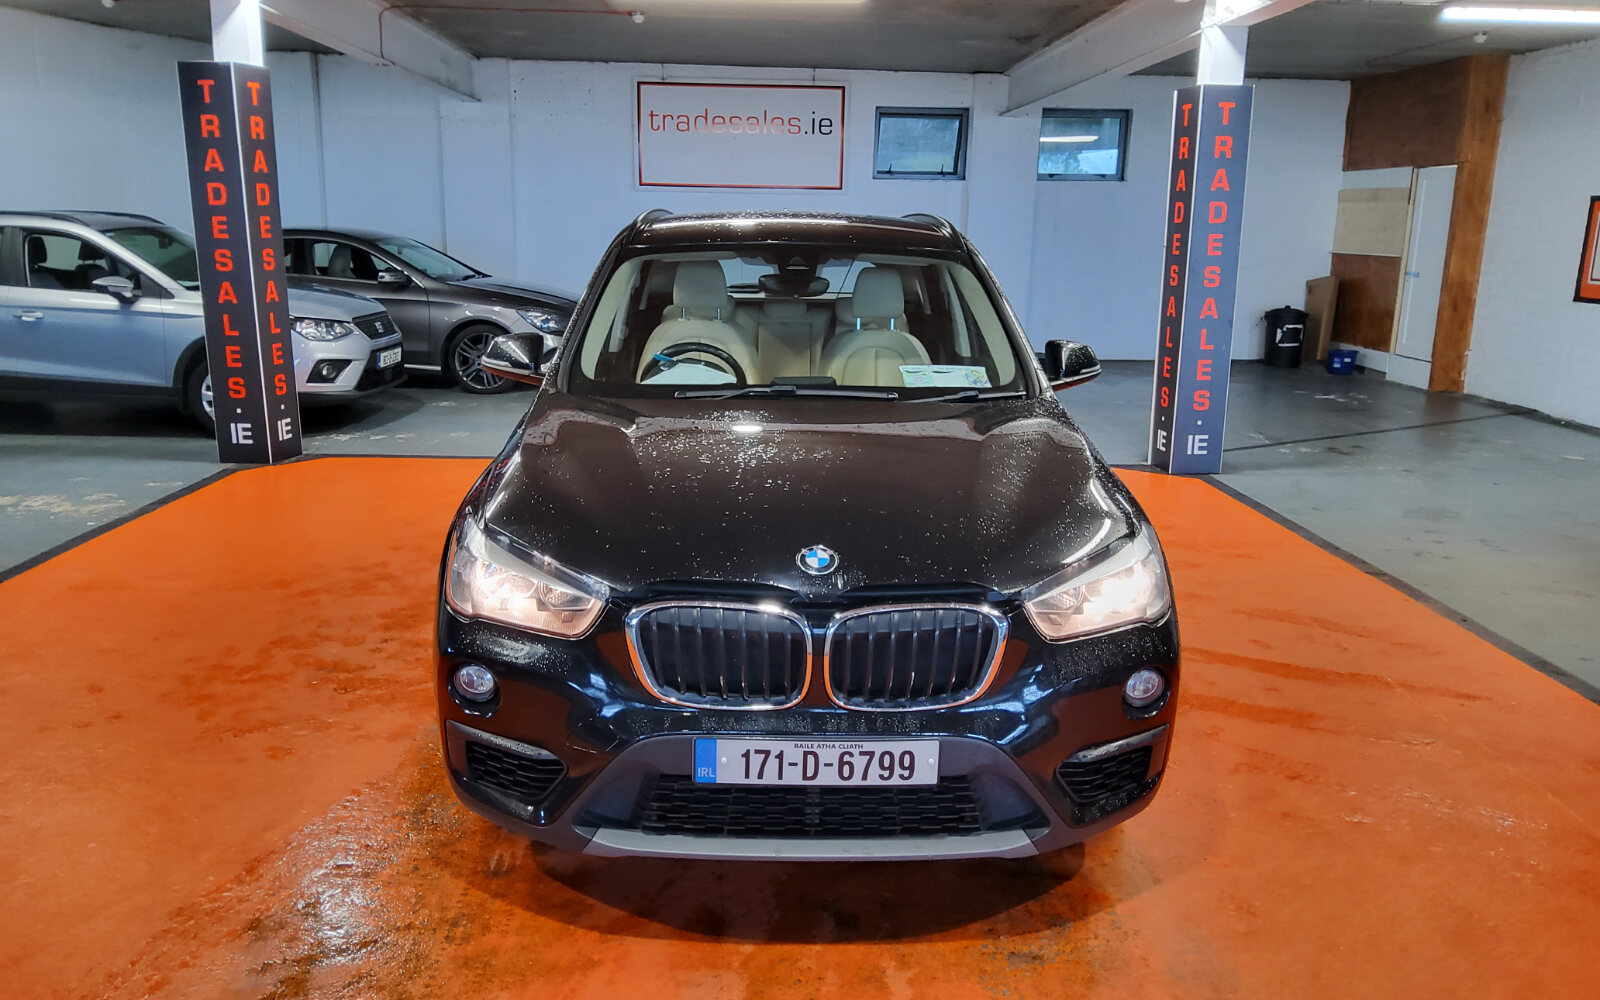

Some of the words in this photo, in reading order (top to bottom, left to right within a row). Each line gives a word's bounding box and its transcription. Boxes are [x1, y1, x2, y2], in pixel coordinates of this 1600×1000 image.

[197, 79, 253, 445] TRADESALES.IE
[246, 81, 293, 442] TRADESALES.IE
[648, 108, 833, 135] tradesales.ie
[1157, 103, 1192, 452] TRADESALES.IE
[1186, 102, 1236, 455] TRADESALES.IE
[697, 767, 716, 778] IRL
[741, 749, 916, 781] 171-D-6799
